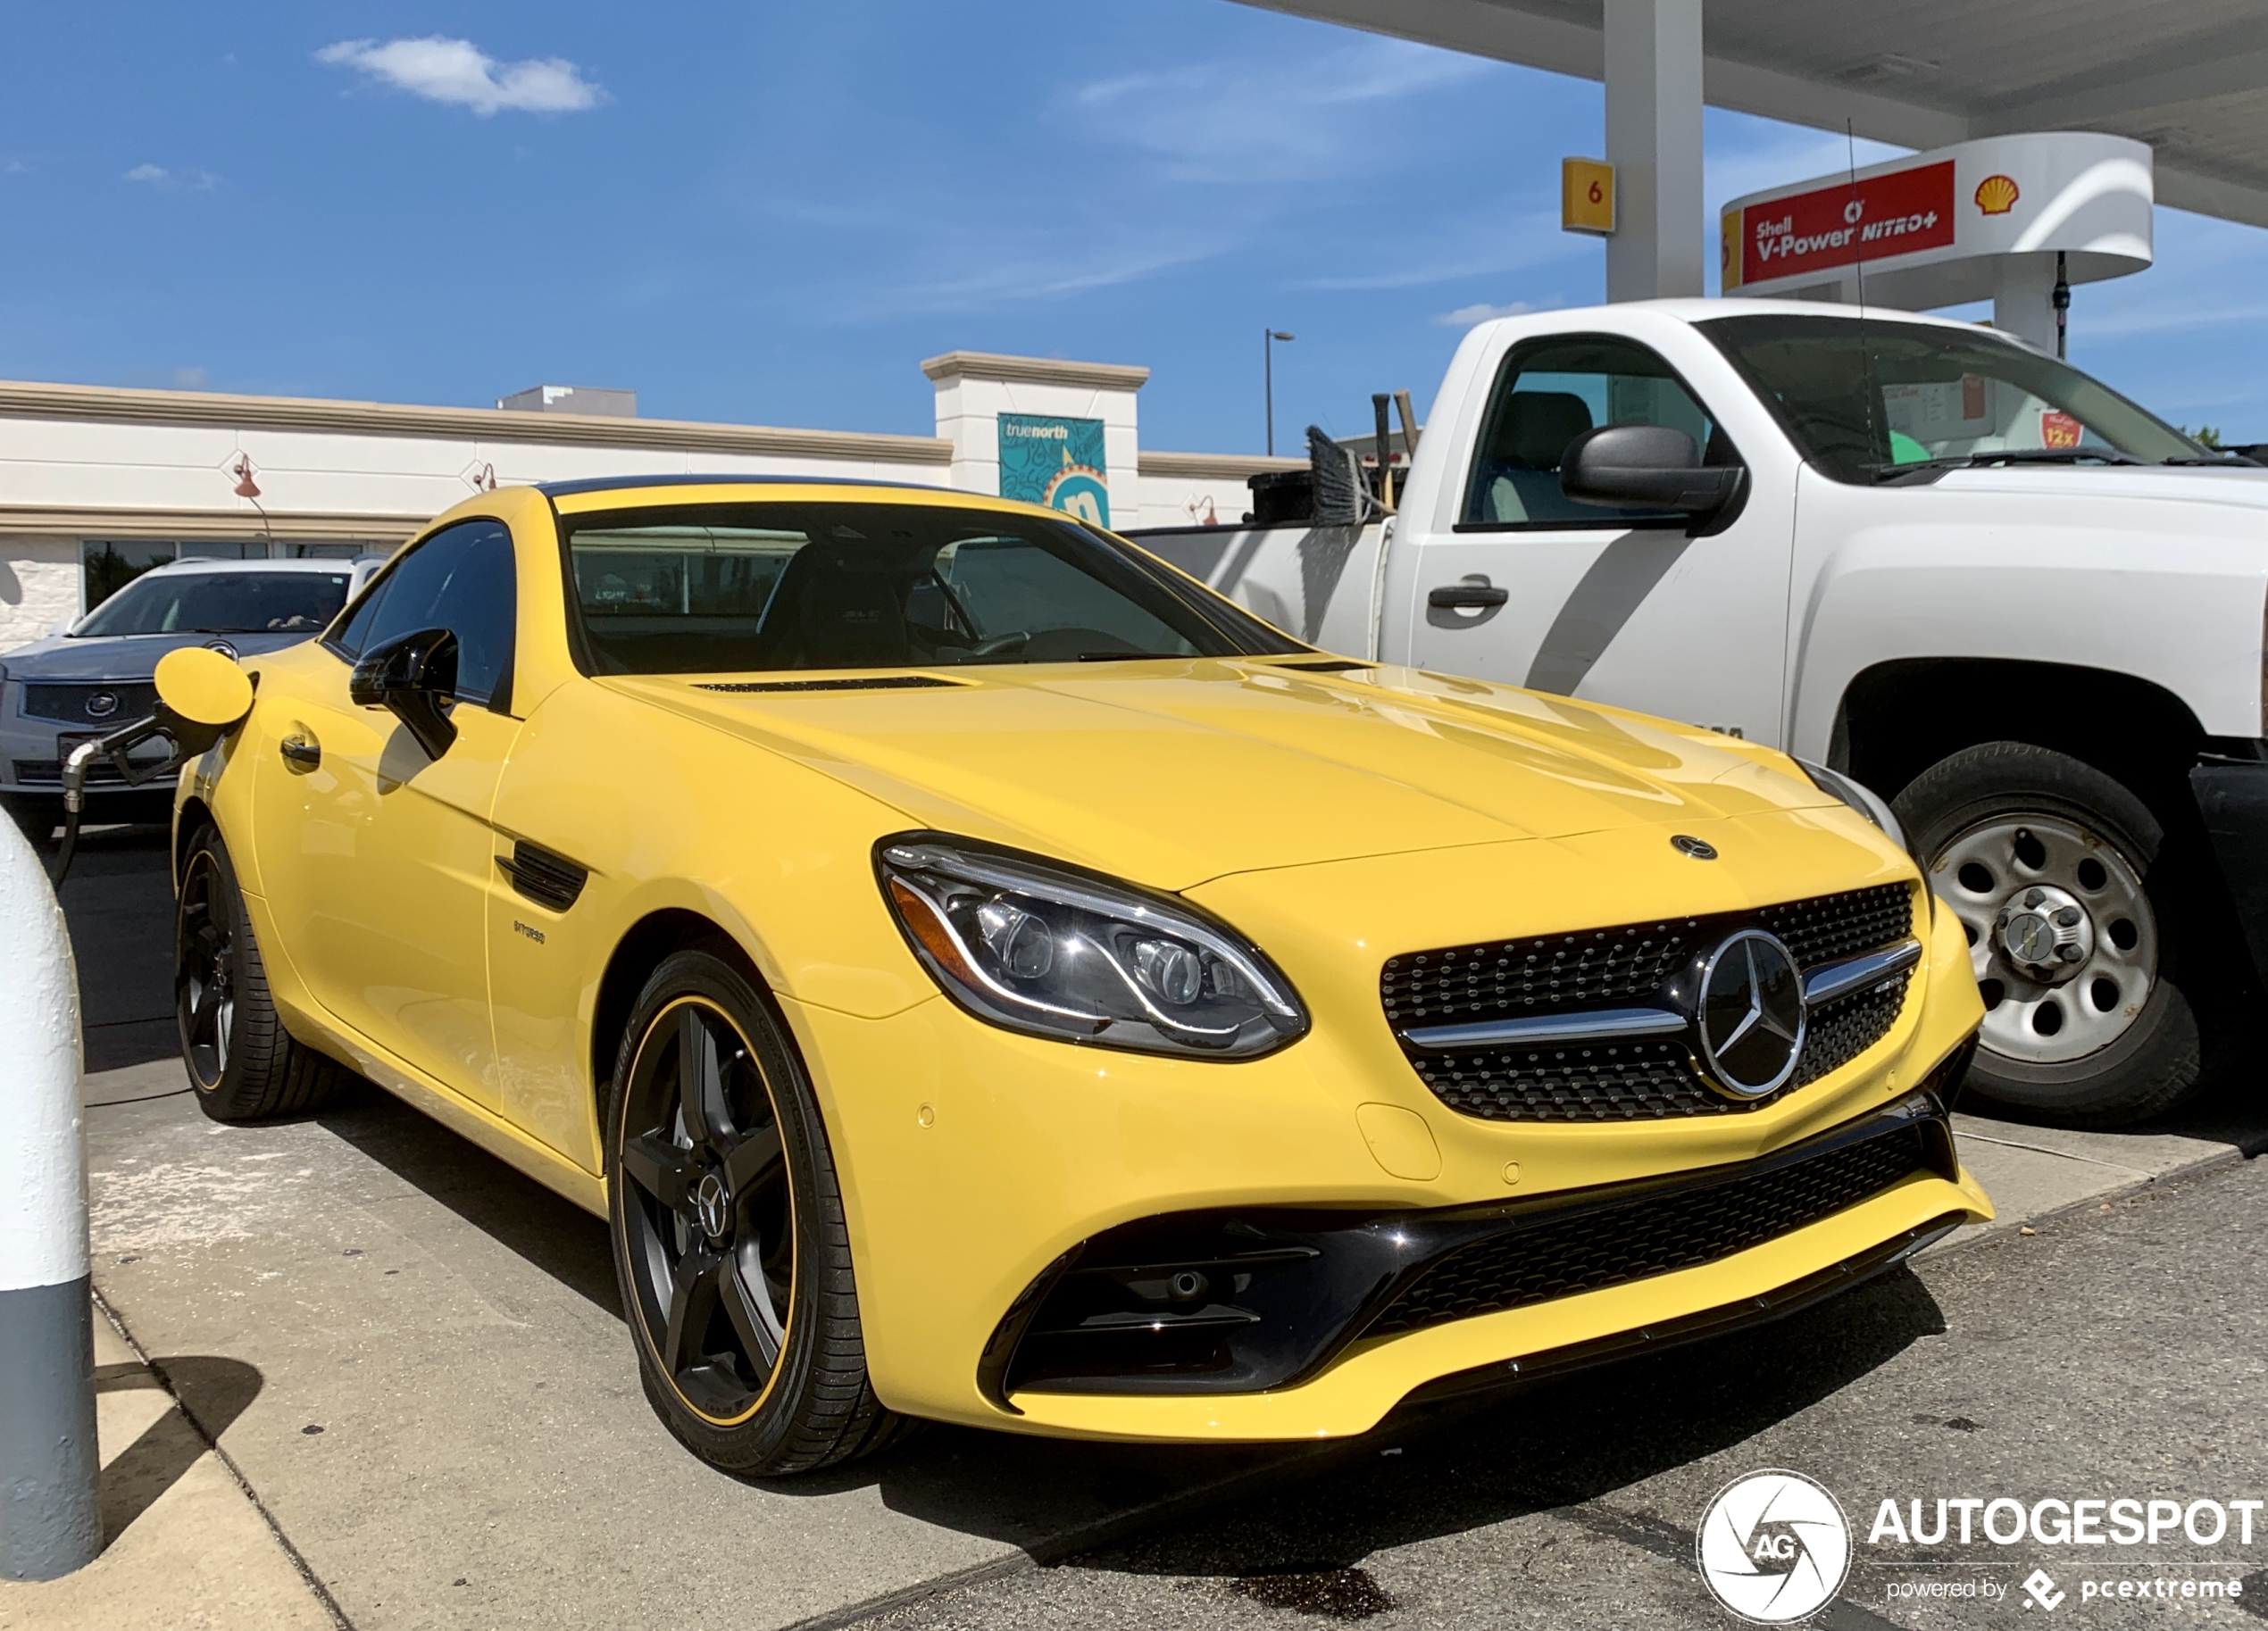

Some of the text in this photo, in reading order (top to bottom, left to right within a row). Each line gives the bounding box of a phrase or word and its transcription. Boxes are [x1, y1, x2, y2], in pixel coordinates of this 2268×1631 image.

[1588, 180, 1603, 204] 6
[1756, 215, 1793, 239] Shell
[1756, 210, 1939, 262] V-Power NITRO+
[1006, 422, 1068, 440] truenorth
